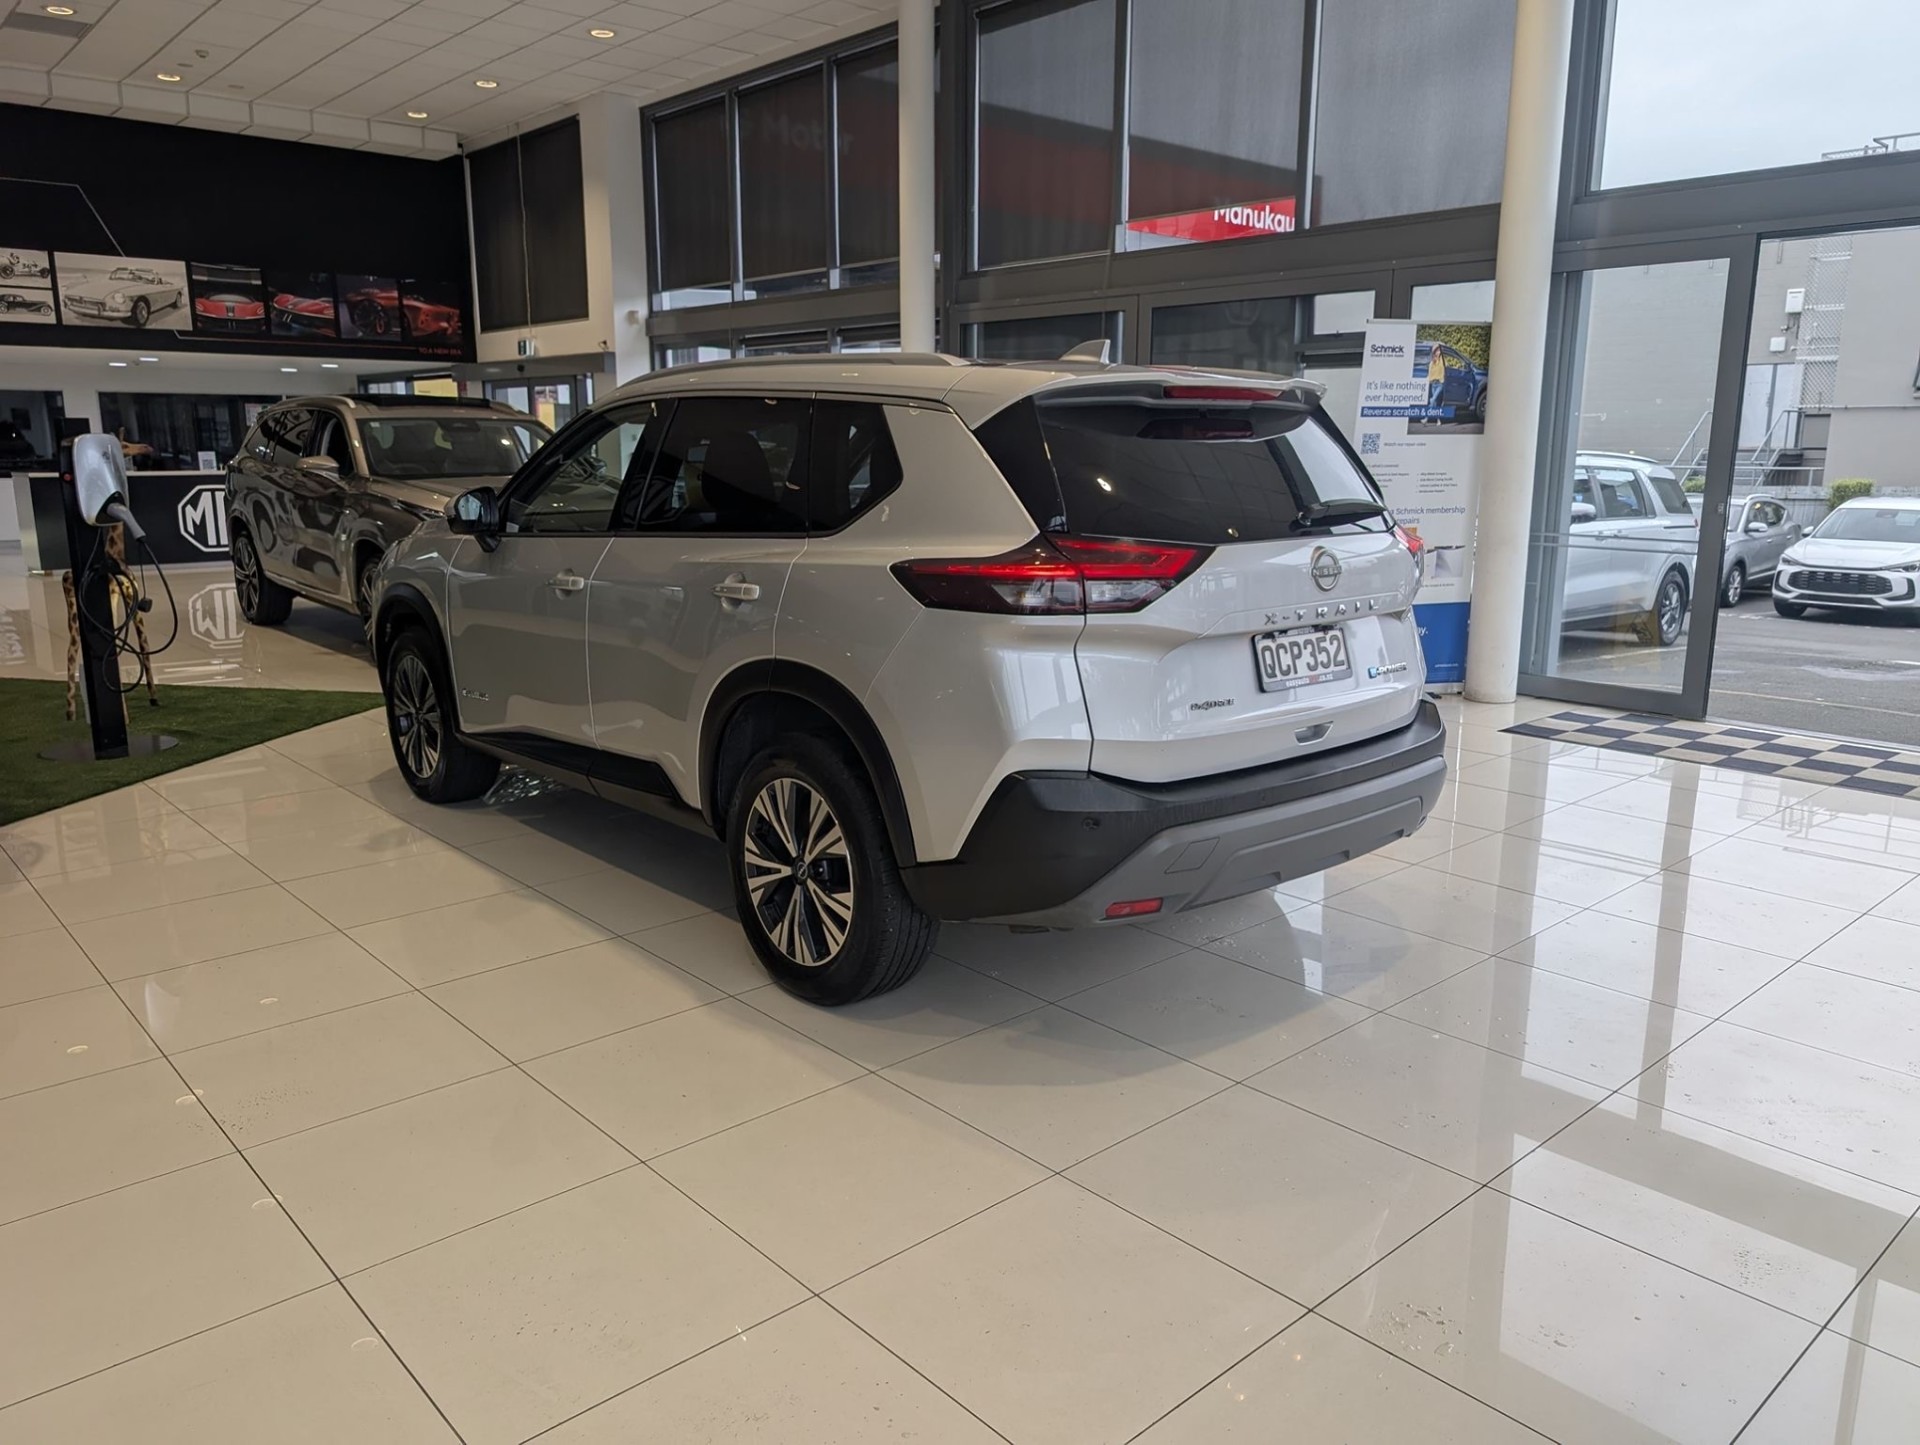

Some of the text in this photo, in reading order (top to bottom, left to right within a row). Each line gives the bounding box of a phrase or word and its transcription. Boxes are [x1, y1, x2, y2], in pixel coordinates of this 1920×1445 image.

[1214, 201, 1295, 233] Manukau
[1370, 344, 1404, 353] Schmick
[1366, 381, 1426, 392] It's like nothing
[1383, 393, 1425, 404] happened.
[1363, 407, 1391, 416] Reverse
[1393, 408, 1419, 416] scratch
[1427, 408, 1444, 416] dent.
[1396, 506, 1425, 515] Schmick
[1425, 505, 1465, 515] membership
[1396, 517, 1420, 525] repairs
[1264, 599, 1380, 626] X-TRAIL
[1260, 634, 1346, 679] QCP352
